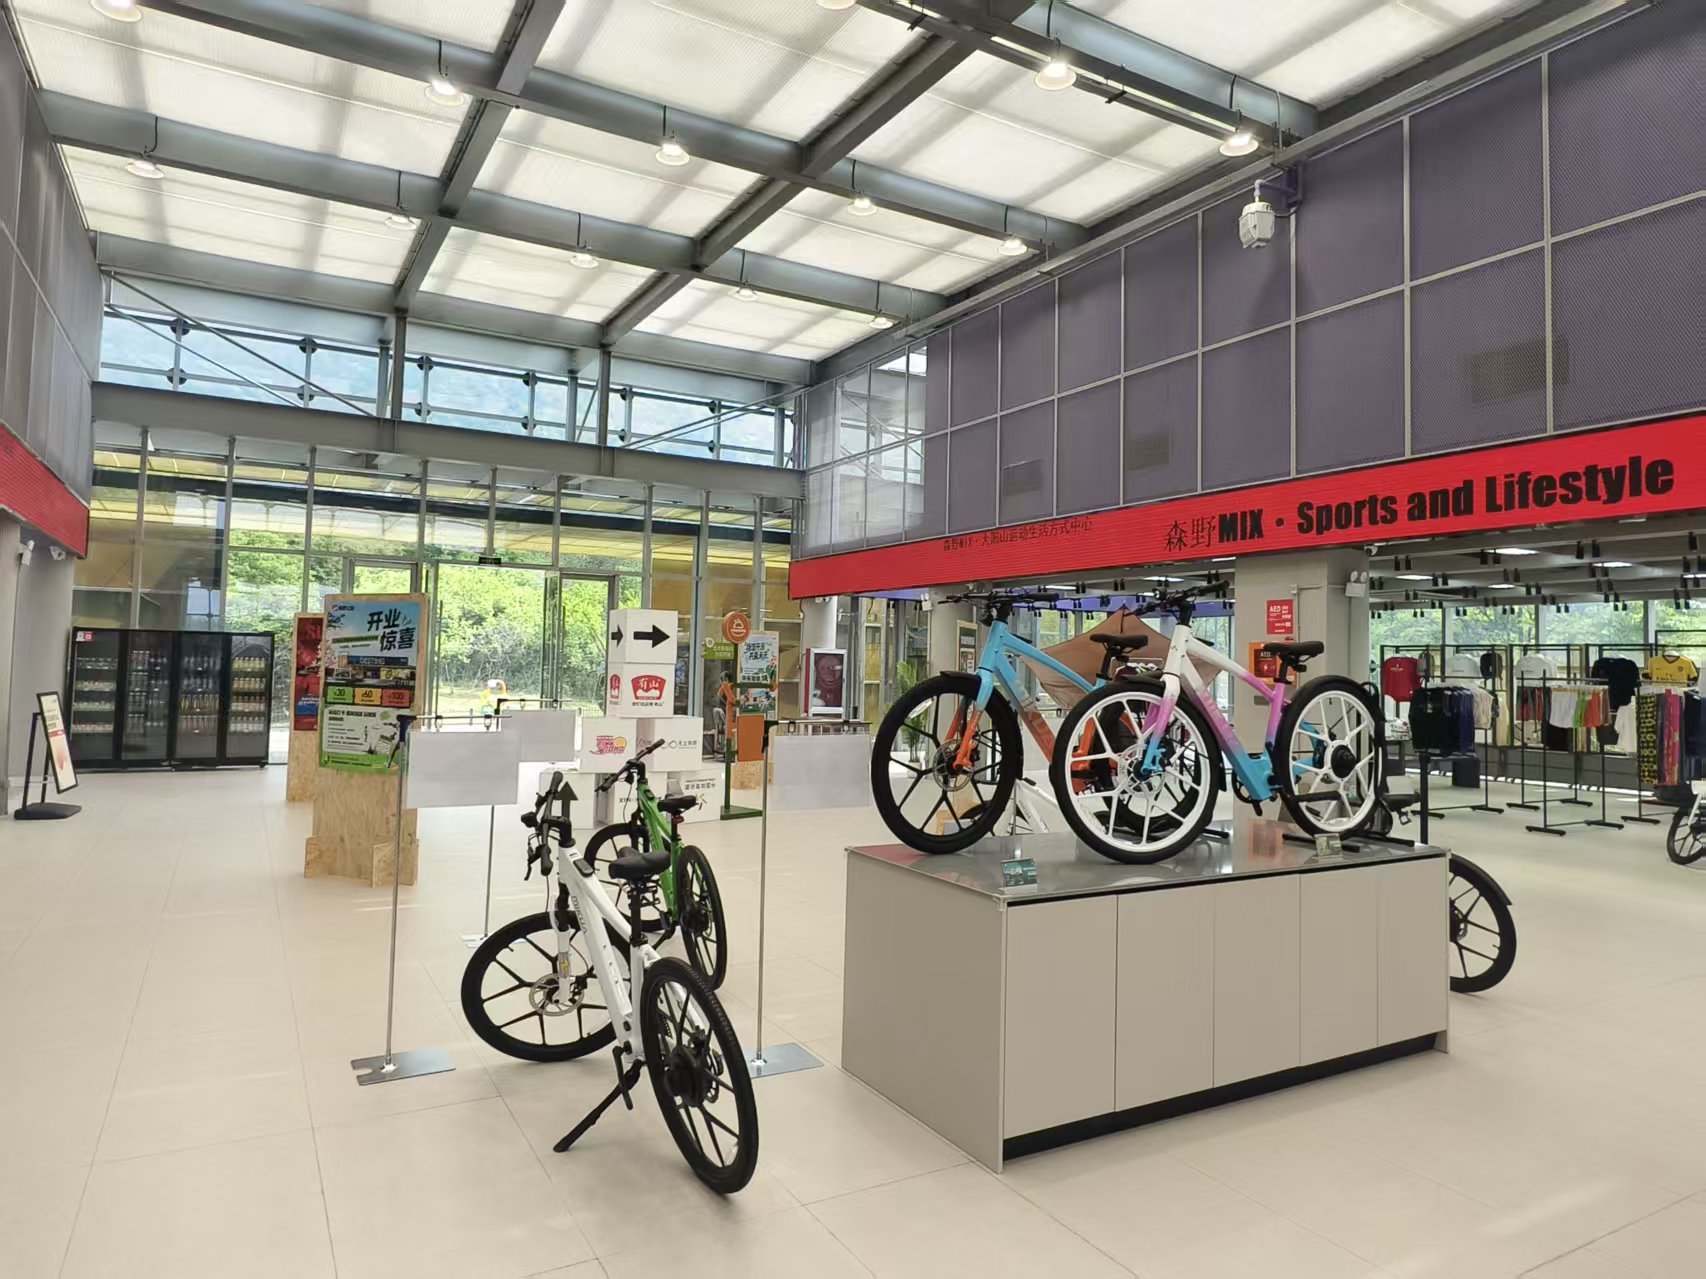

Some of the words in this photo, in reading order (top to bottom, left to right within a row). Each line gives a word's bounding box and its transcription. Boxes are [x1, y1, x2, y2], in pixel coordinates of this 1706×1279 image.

[1297, 494, 1398, 536] Sports
[1407, 480, 1474, 521] and
[1485, 455, 1674, 513] Lifestyle
[366, 608, 402, 632] 开业
[1269, 605, 1281, 613] AED
[380, 627, 417, 652] 惊喜
